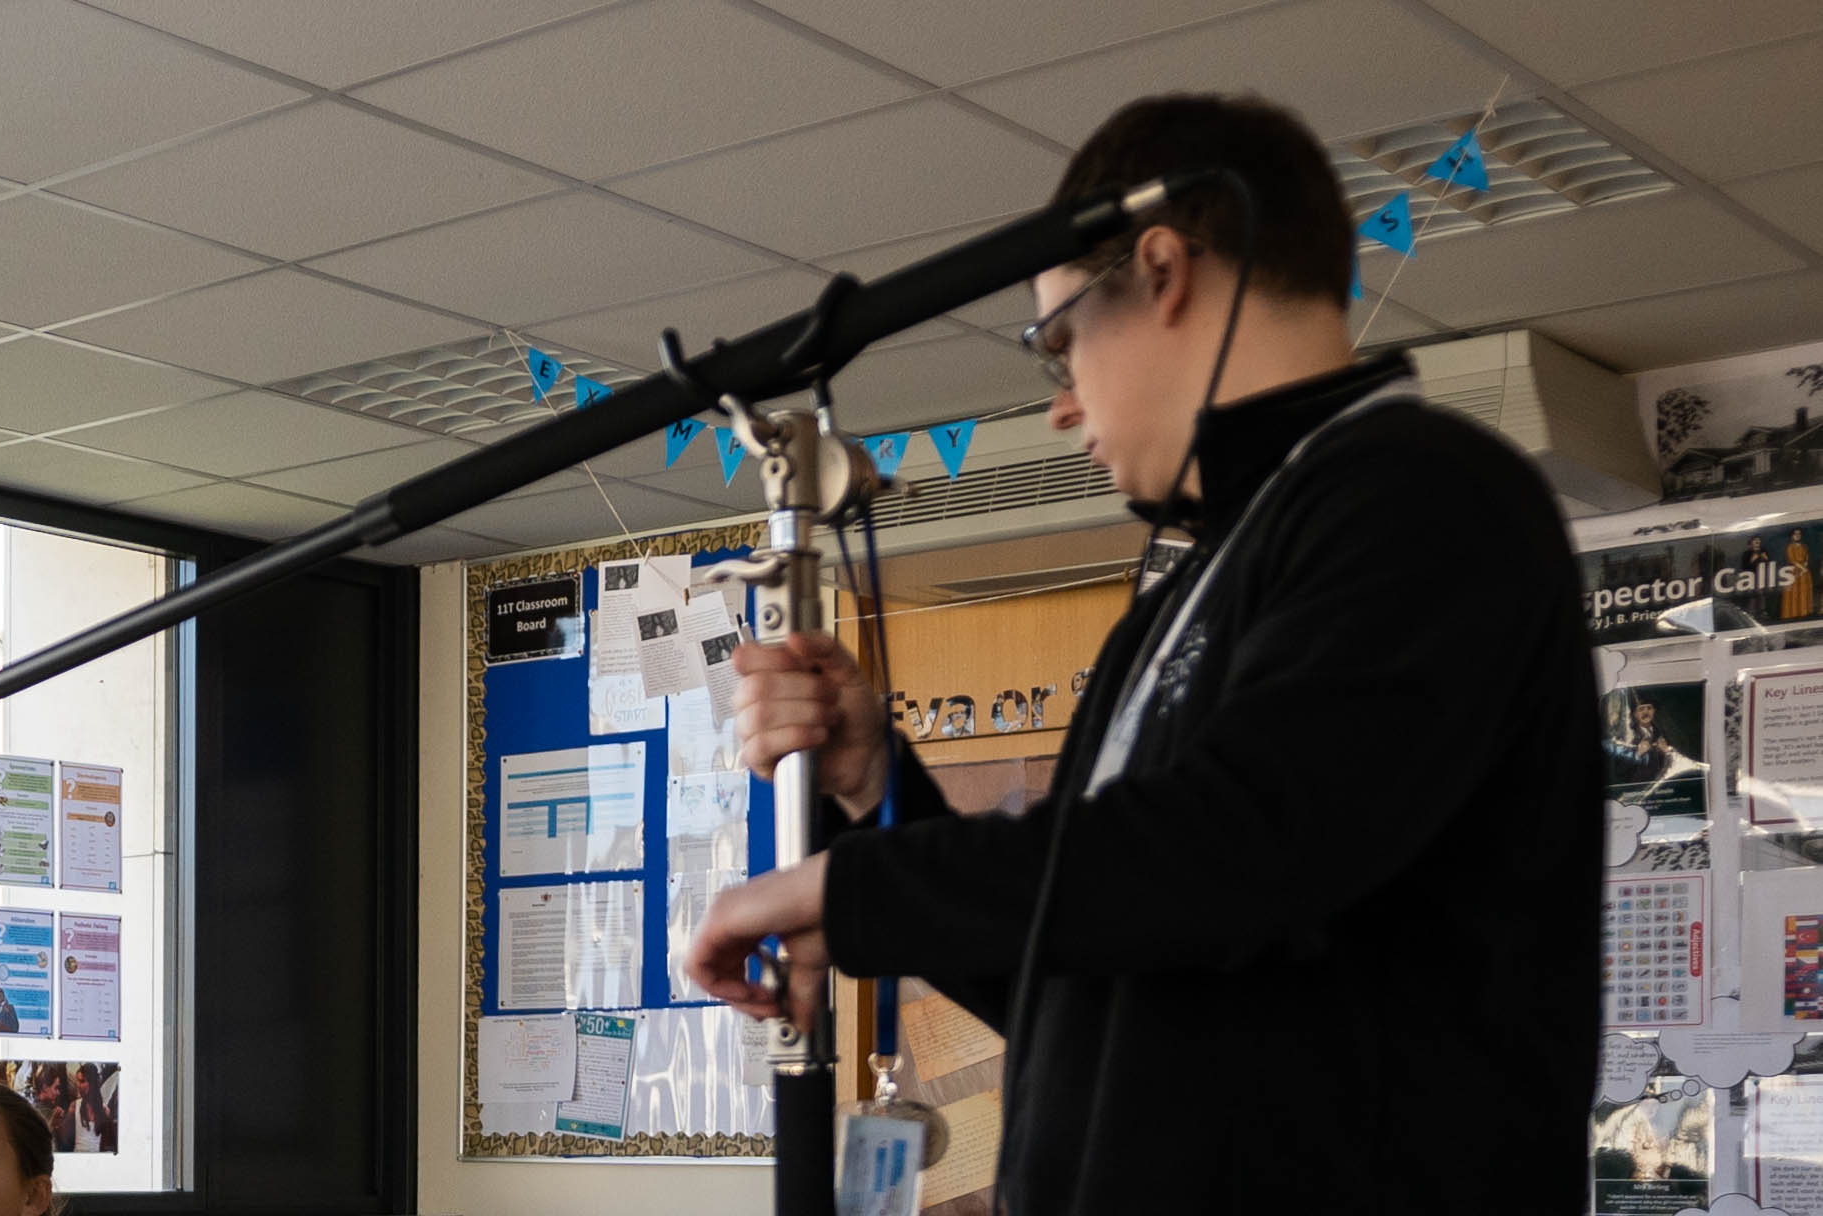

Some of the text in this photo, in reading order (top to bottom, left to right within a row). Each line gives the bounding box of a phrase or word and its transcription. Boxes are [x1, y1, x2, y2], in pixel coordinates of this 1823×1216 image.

[1713, 560, 1796, 594] Calls
[496, 595, 569, 615] 11T Classroom
[516, 618, 547, 632] Board
[1765, 688, 1788, 700] Key
[990, 683, 1058, 734] or
